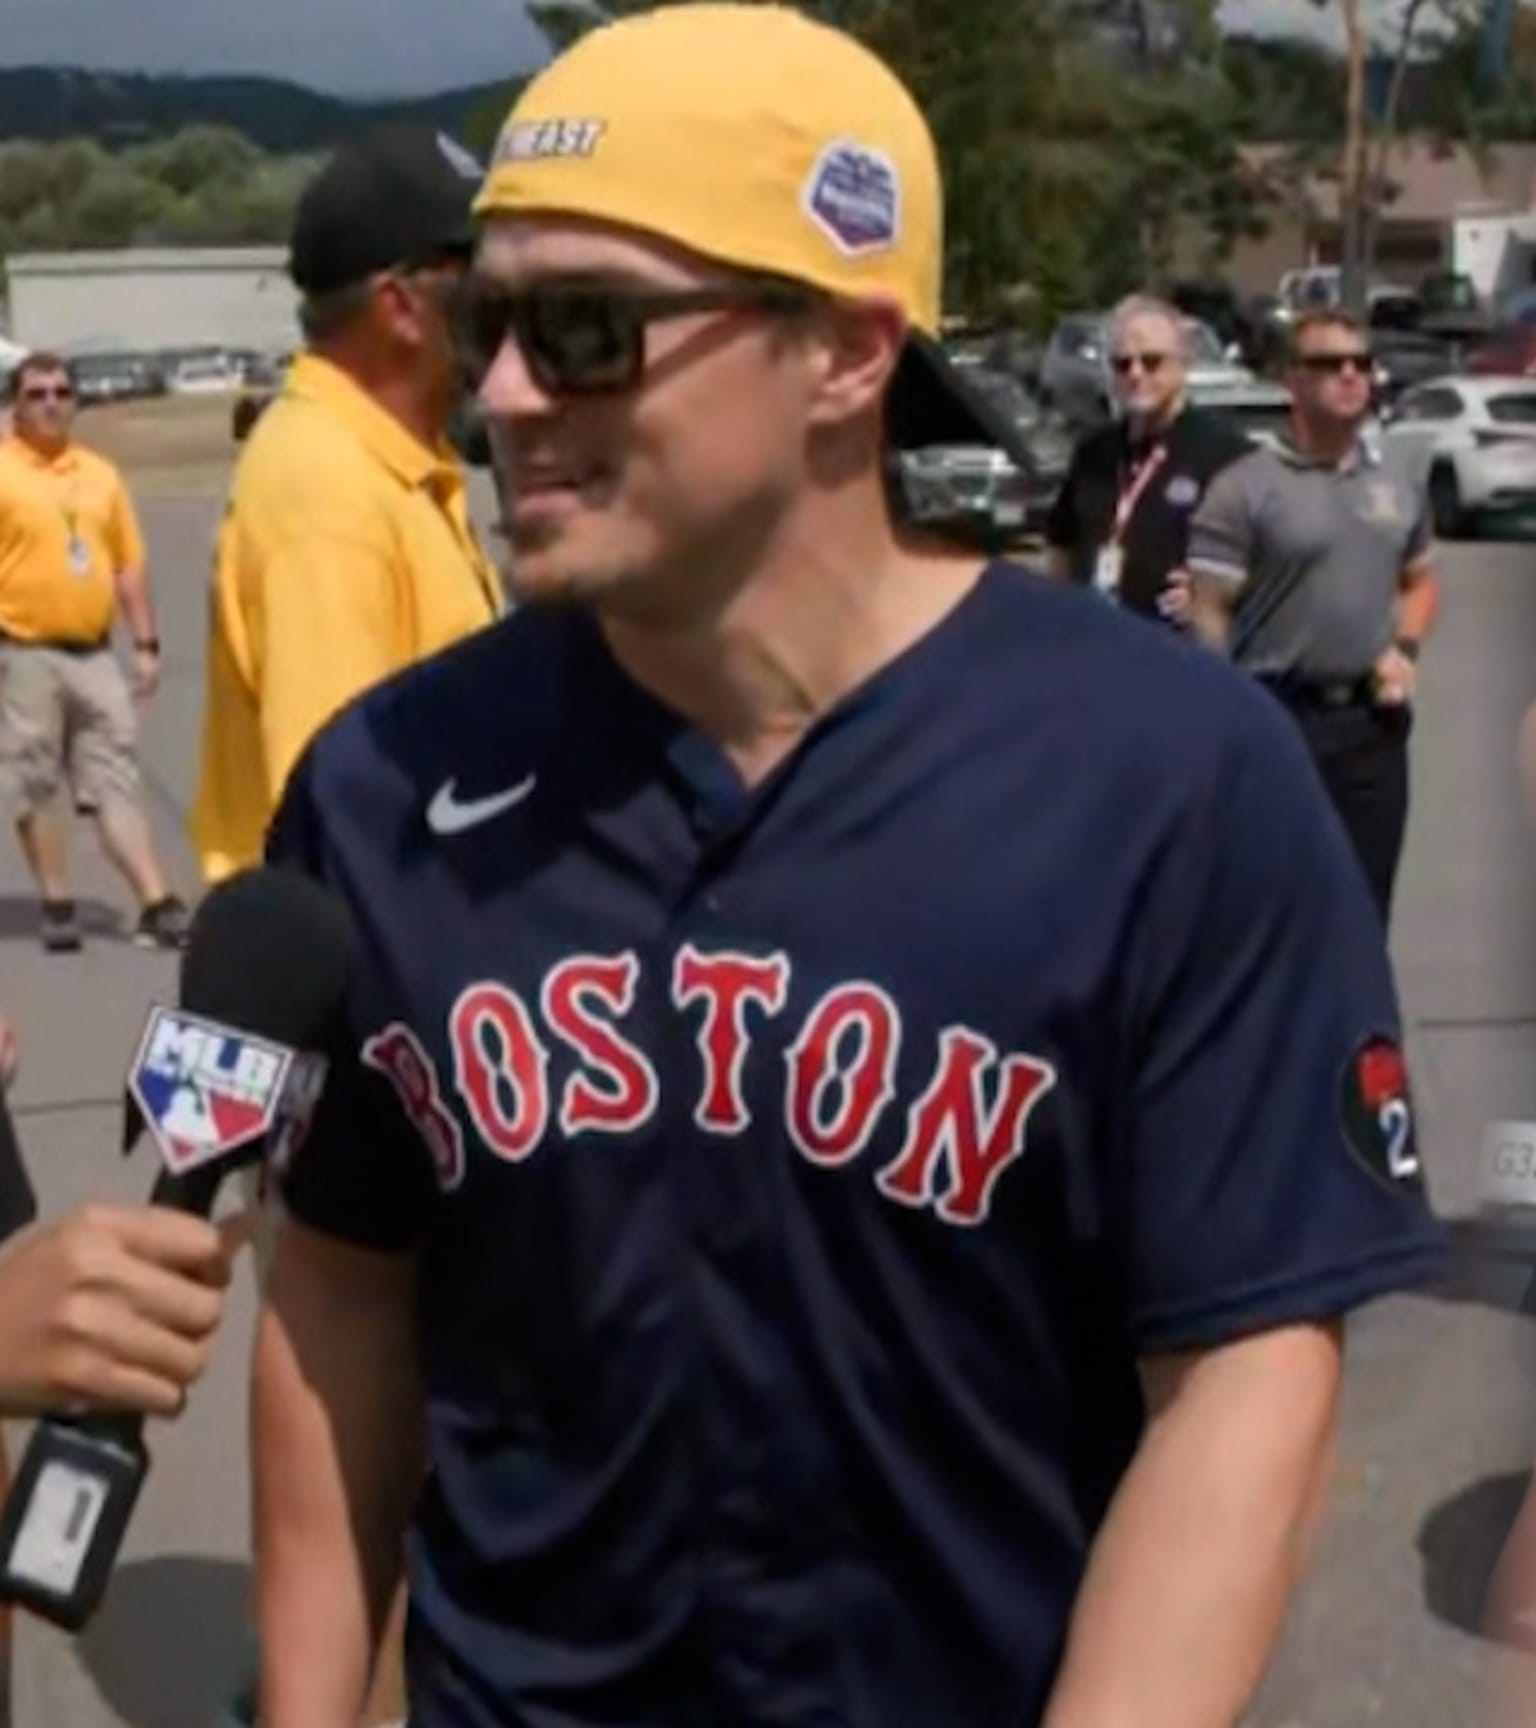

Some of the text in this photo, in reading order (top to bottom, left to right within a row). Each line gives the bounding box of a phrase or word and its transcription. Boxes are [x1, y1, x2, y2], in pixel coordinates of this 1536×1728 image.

[147, 1014, 283, 1097] MLB
[362, 942, 1057, 1227] BOSTON
[1378, 1097, 1419, 1178] 2
